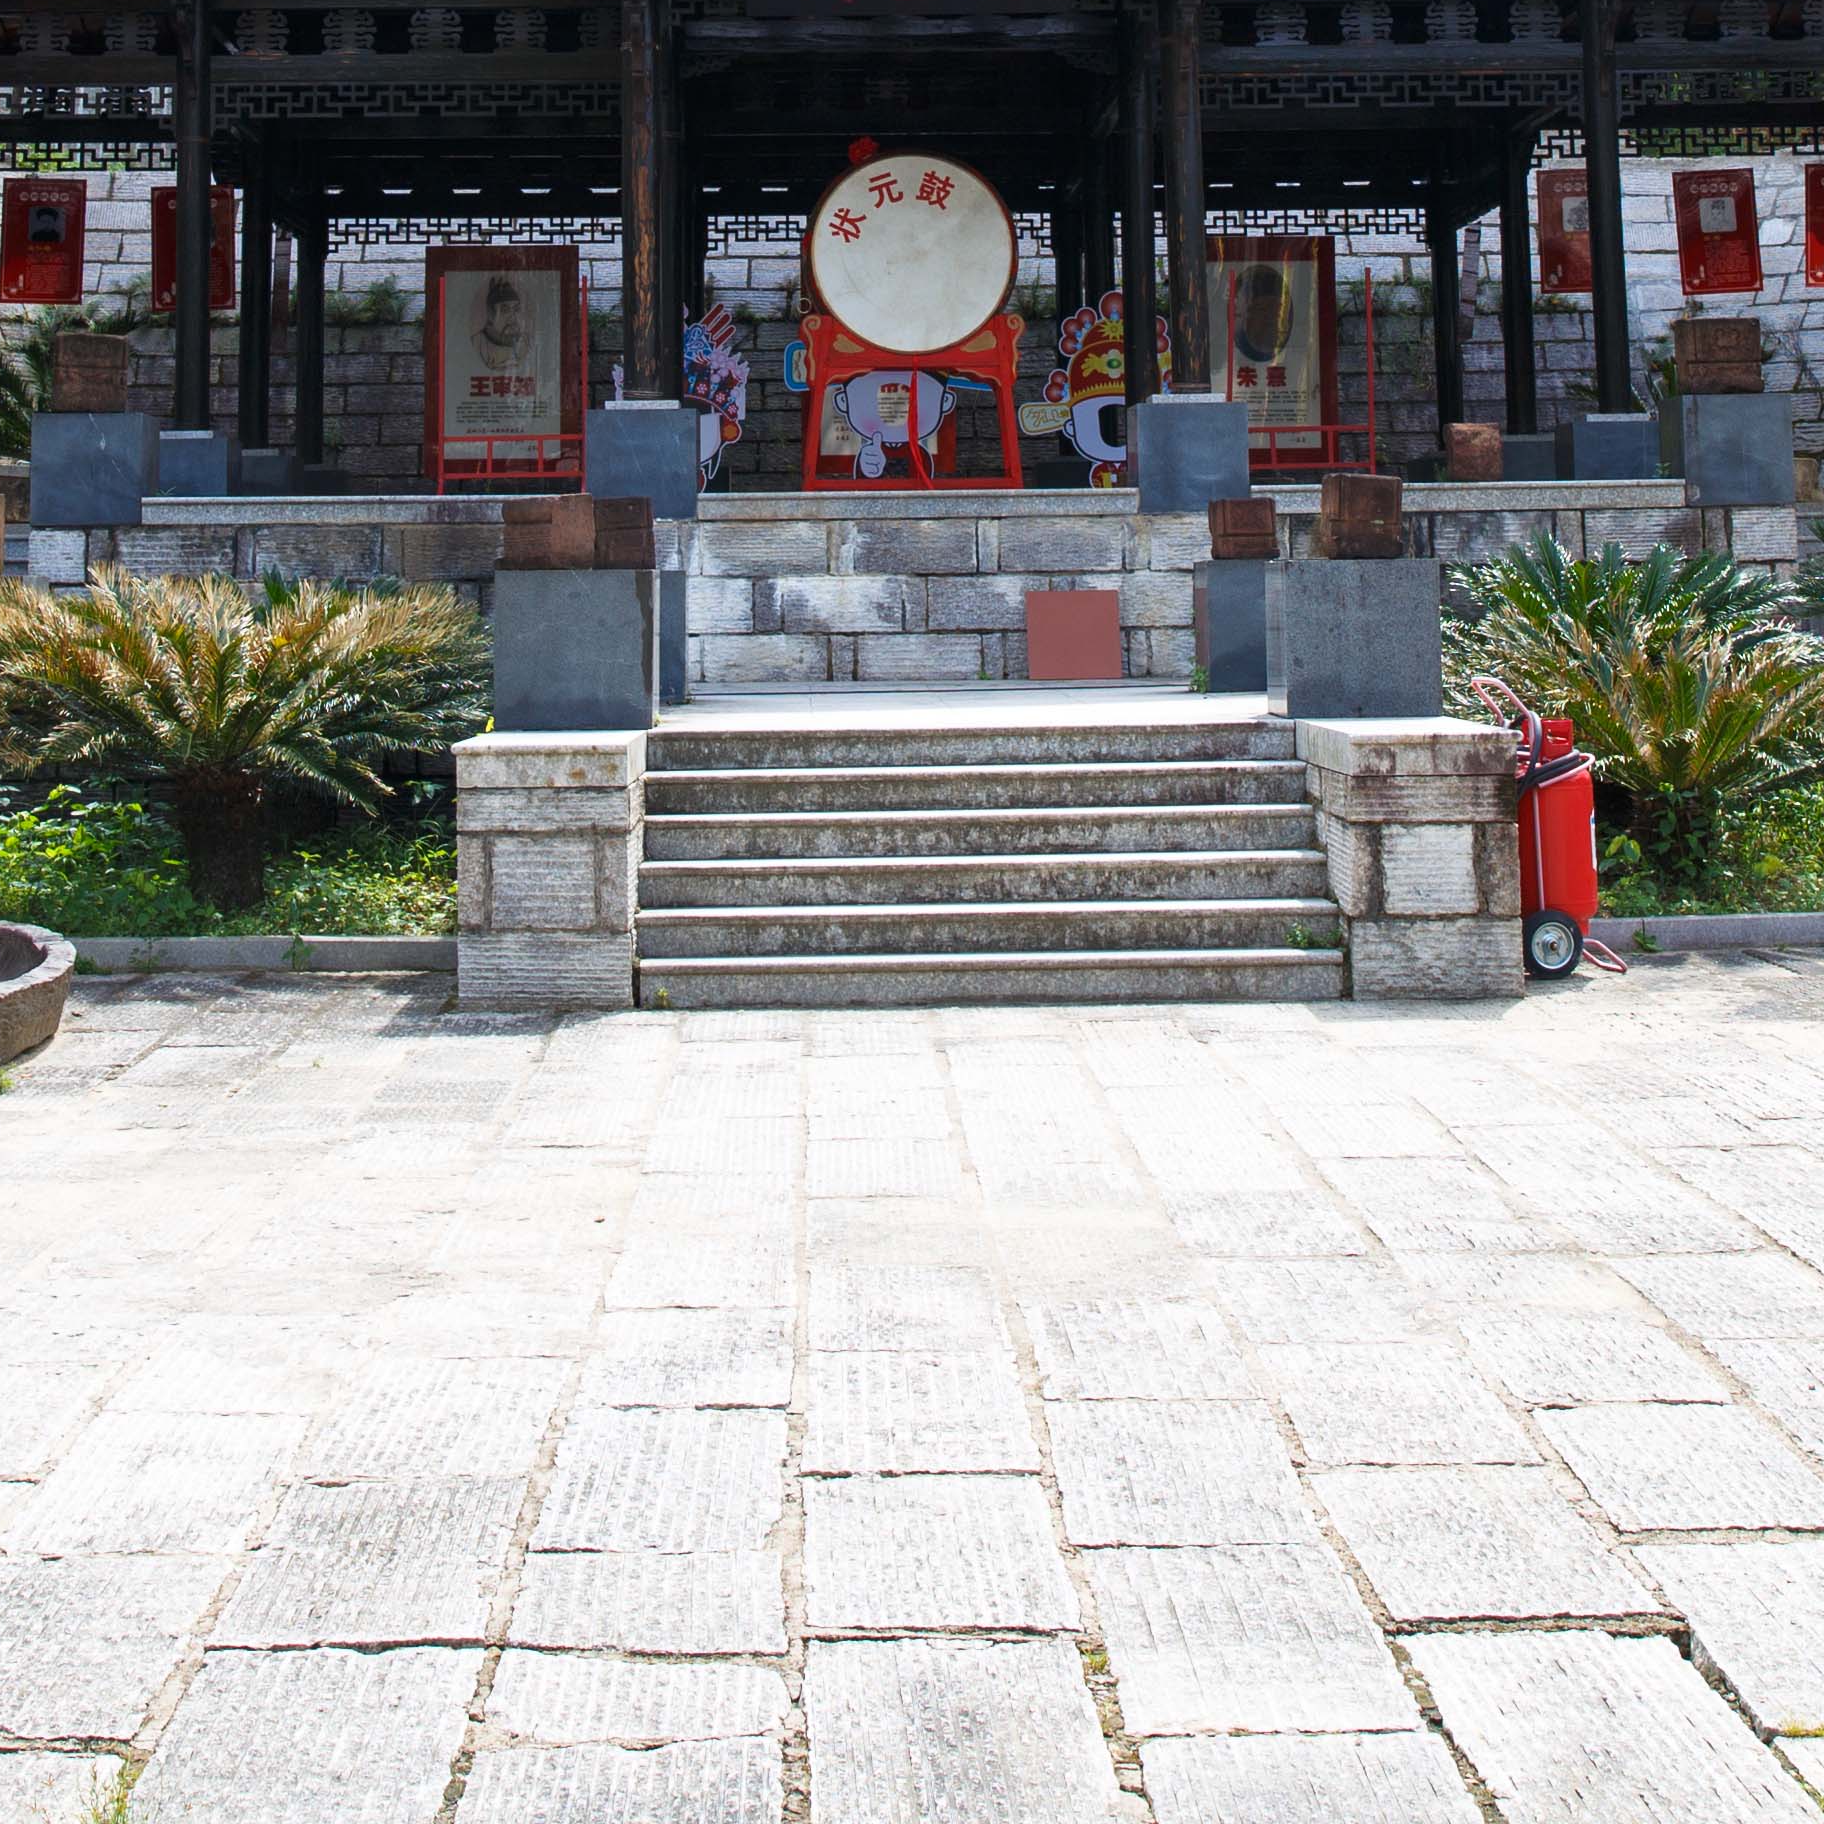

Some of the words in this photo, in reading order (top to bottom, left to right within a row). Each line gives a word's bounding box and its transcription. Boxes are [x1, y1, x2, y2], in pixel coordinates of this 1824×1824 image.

[828, 170, 956, 243] 状元鼓
[469, 375, 536, 398] 王审知
[1236, 365, 1287, 388] 朱熹
